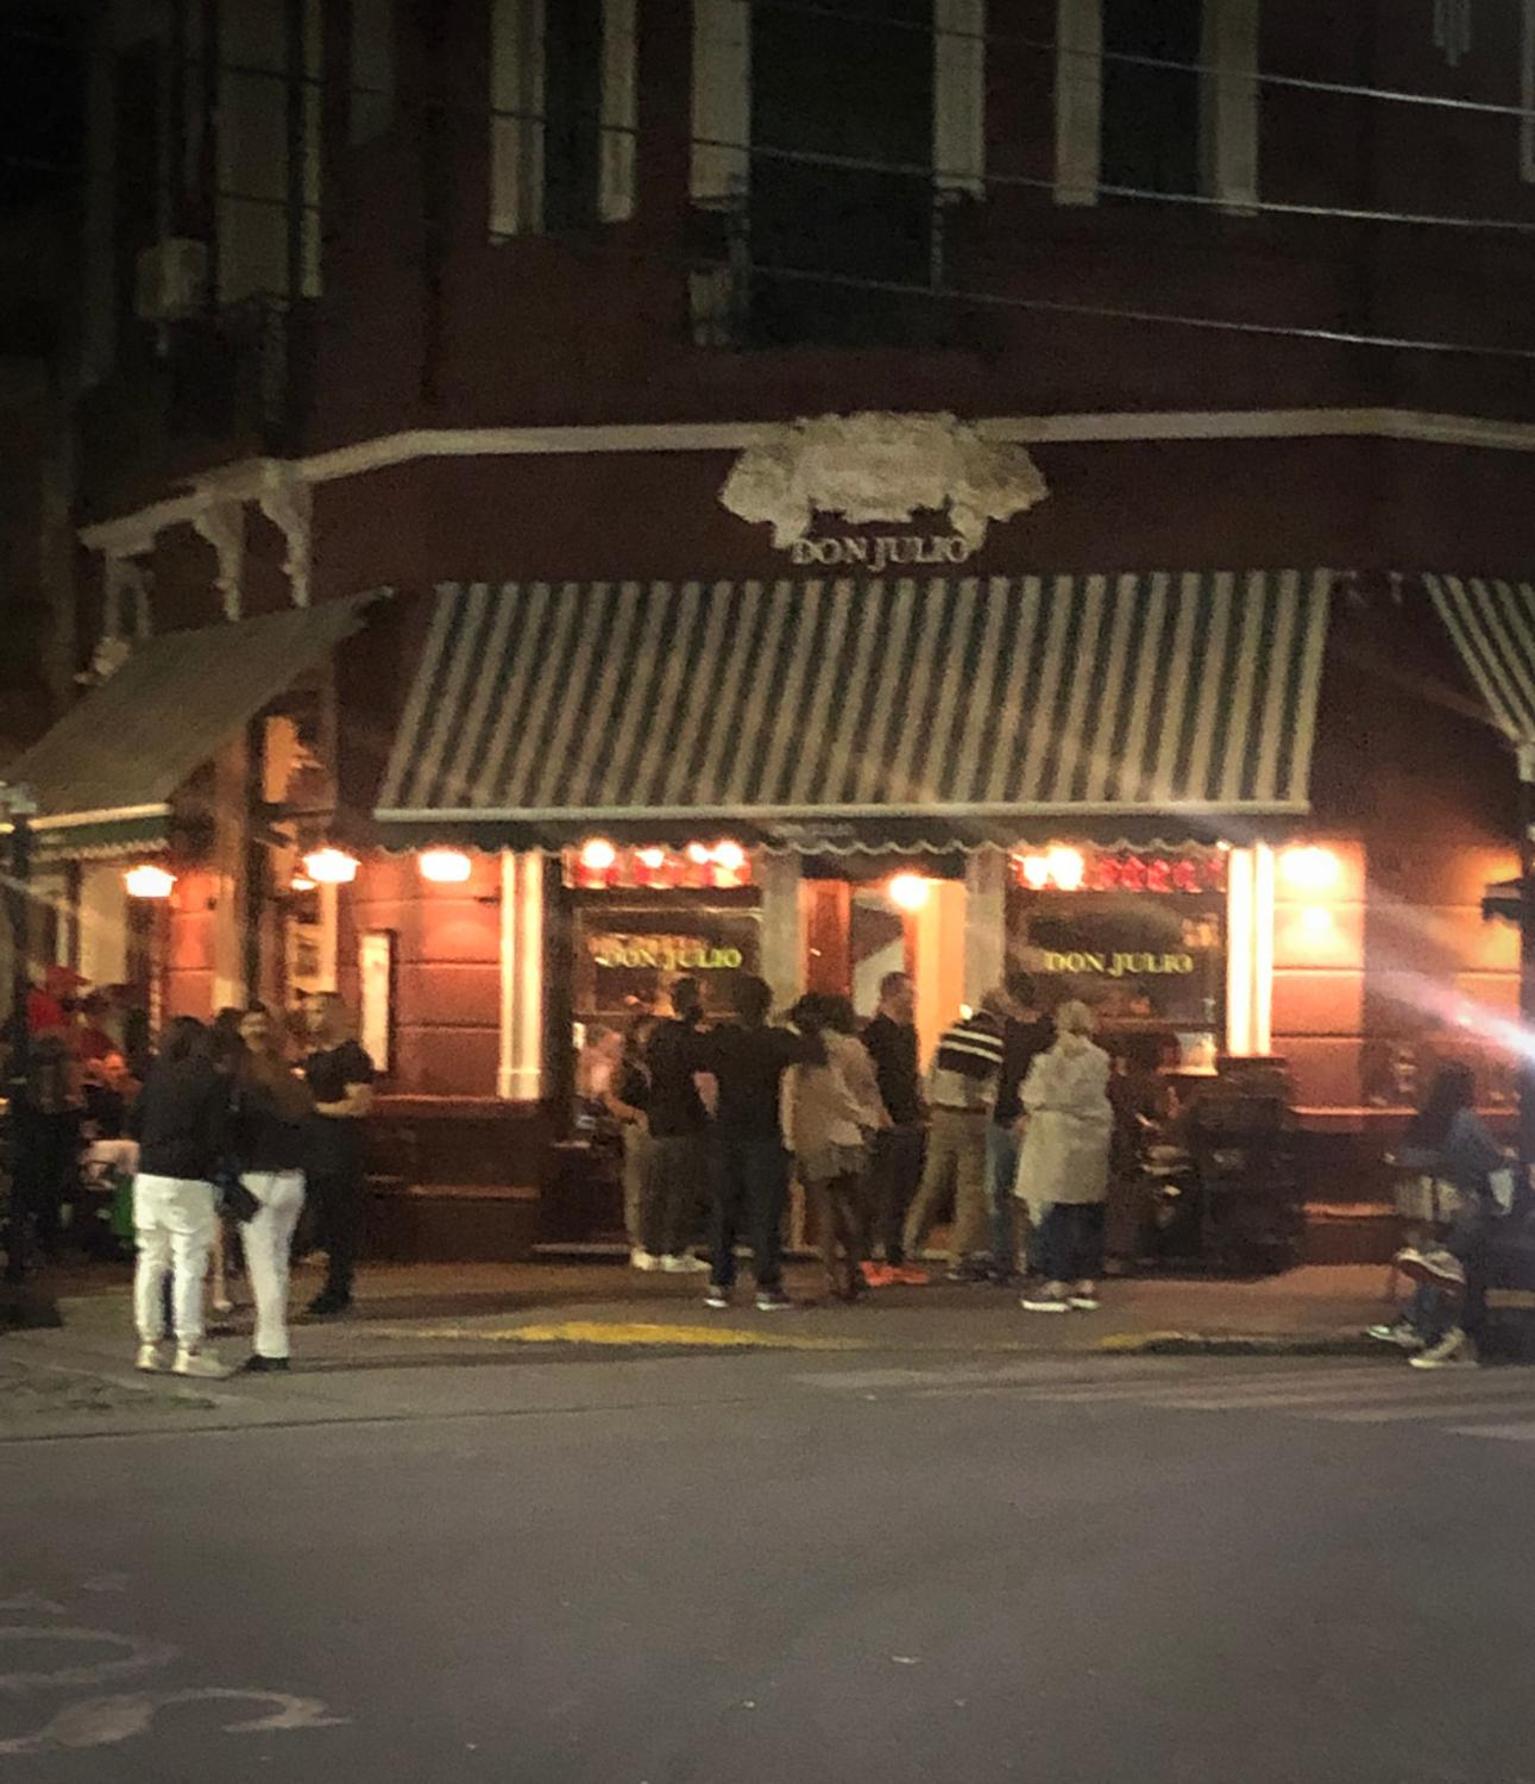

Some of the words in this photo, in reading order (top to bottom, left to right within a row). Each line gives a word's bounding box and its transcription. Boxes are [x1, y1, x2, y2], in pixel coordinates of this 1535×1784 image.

[792, 536, 867, 565] DON
[868, 536, 969, 571] JULIO
[601, 948, 657, 967] DON
[660, 948, 742, 970] JULIO
[1045, 952, 1104, 972] DON
[1107, 951, 1193, 976] JULIO
